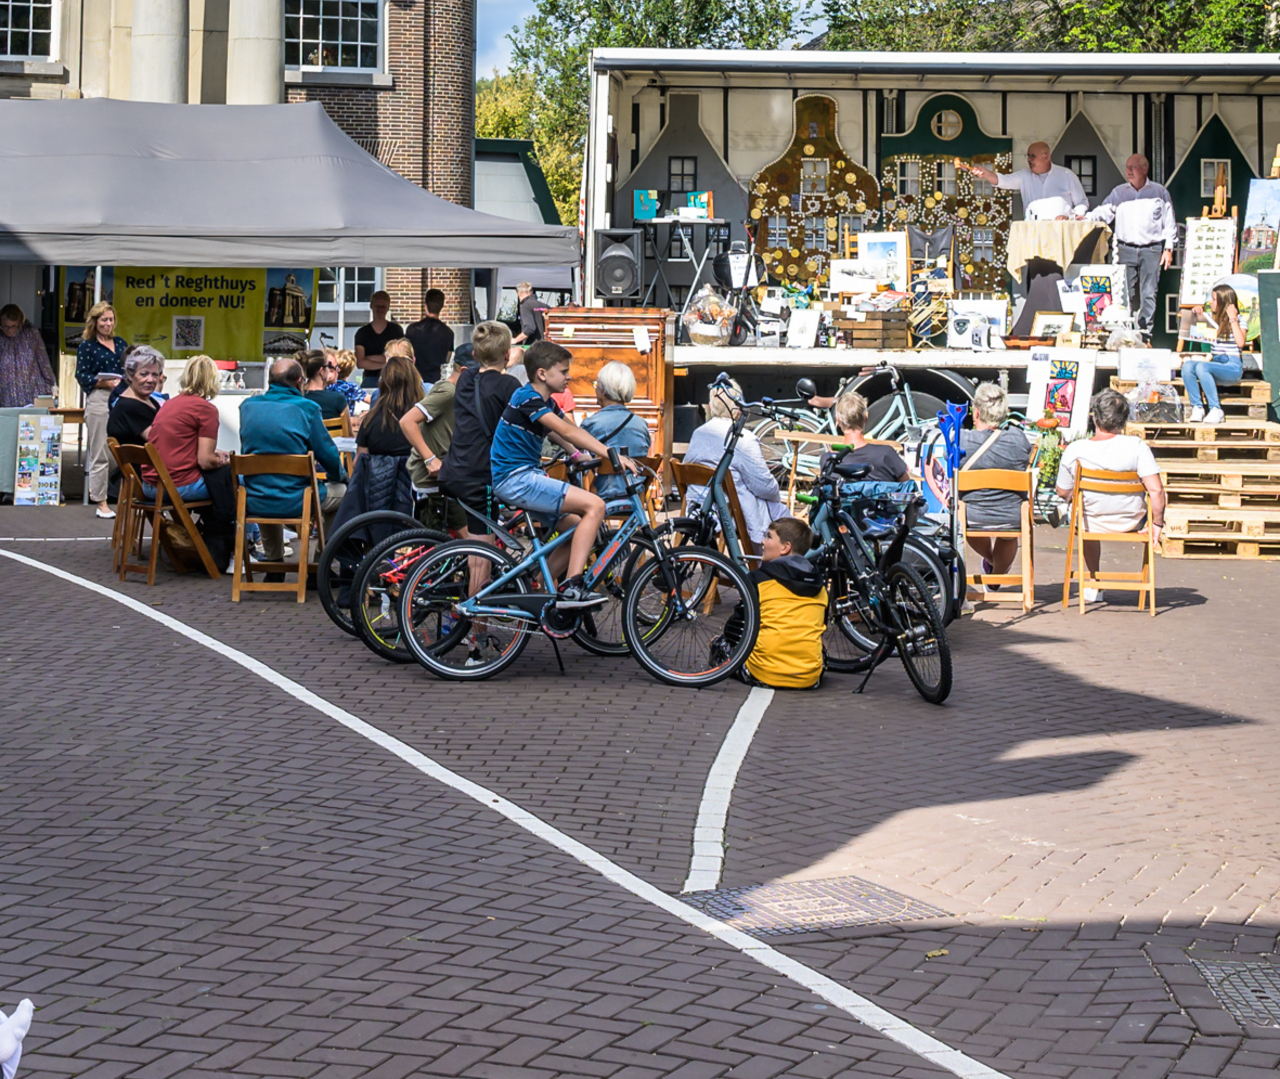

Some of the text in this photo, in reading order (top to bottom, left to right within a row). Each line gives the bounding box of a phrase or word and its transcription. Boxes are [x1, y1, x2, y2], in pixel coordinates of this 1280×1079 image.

[125, 275, 156, 289] Red
[175, 275, 256, 294] Reghthuys
[135, 293, 245, 309] en doneer NU!
[592, 540, 621, 577] ALPINA
